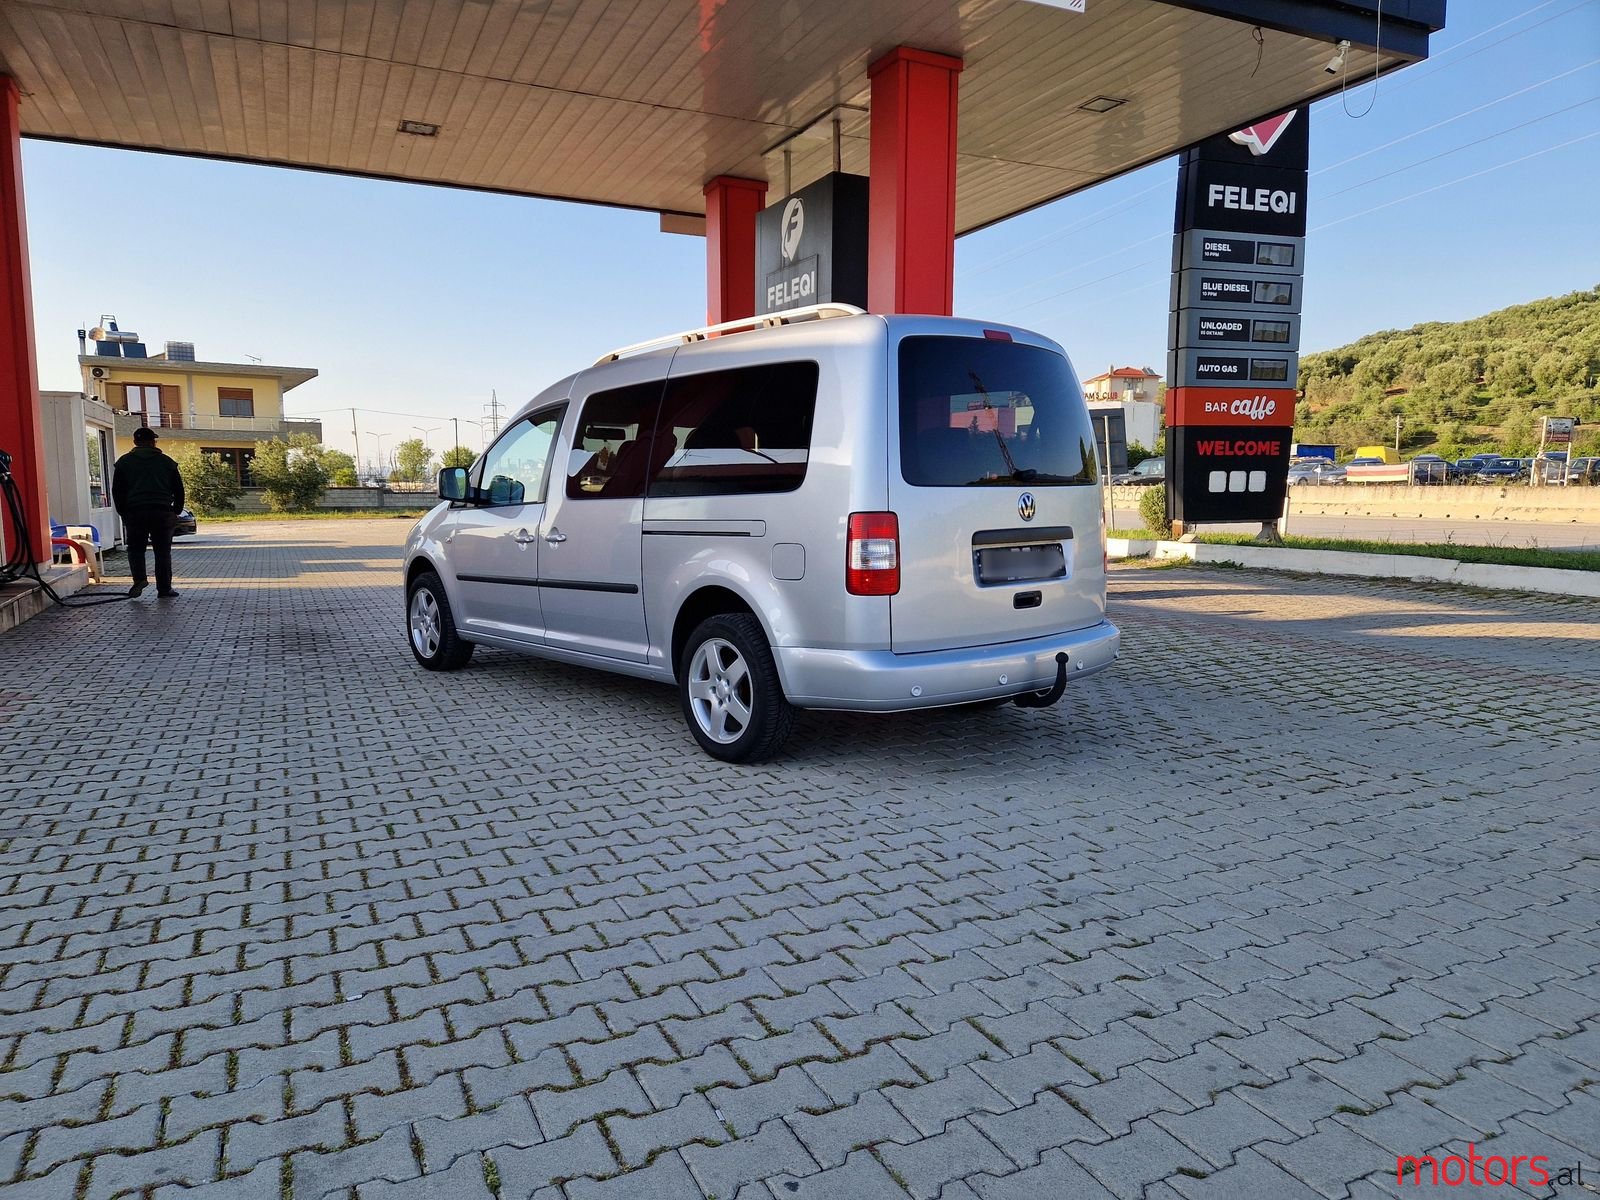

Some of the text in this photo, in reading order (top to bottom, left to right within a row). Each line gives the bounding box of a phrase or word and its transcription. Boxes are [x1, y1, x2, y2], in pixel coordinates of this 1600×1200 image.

[1208, 183, 1297, 214] FELEQI
[1204, 242, 1232, 252] DIESEL
[767, 271, 815, 309] FELEQI
[1202, 282, 1250, 293] BLUE DIESEL
[1201, 321, 1243, 331] UNLOADED
[1198, 364, 1238, 373] AUTO GAS
[1083, 391, 1118, 400] AM'S CLUB
[1205, 395, 1276, 420] BAR caffe
[1197, 441, 1280, 456] WELCOME
